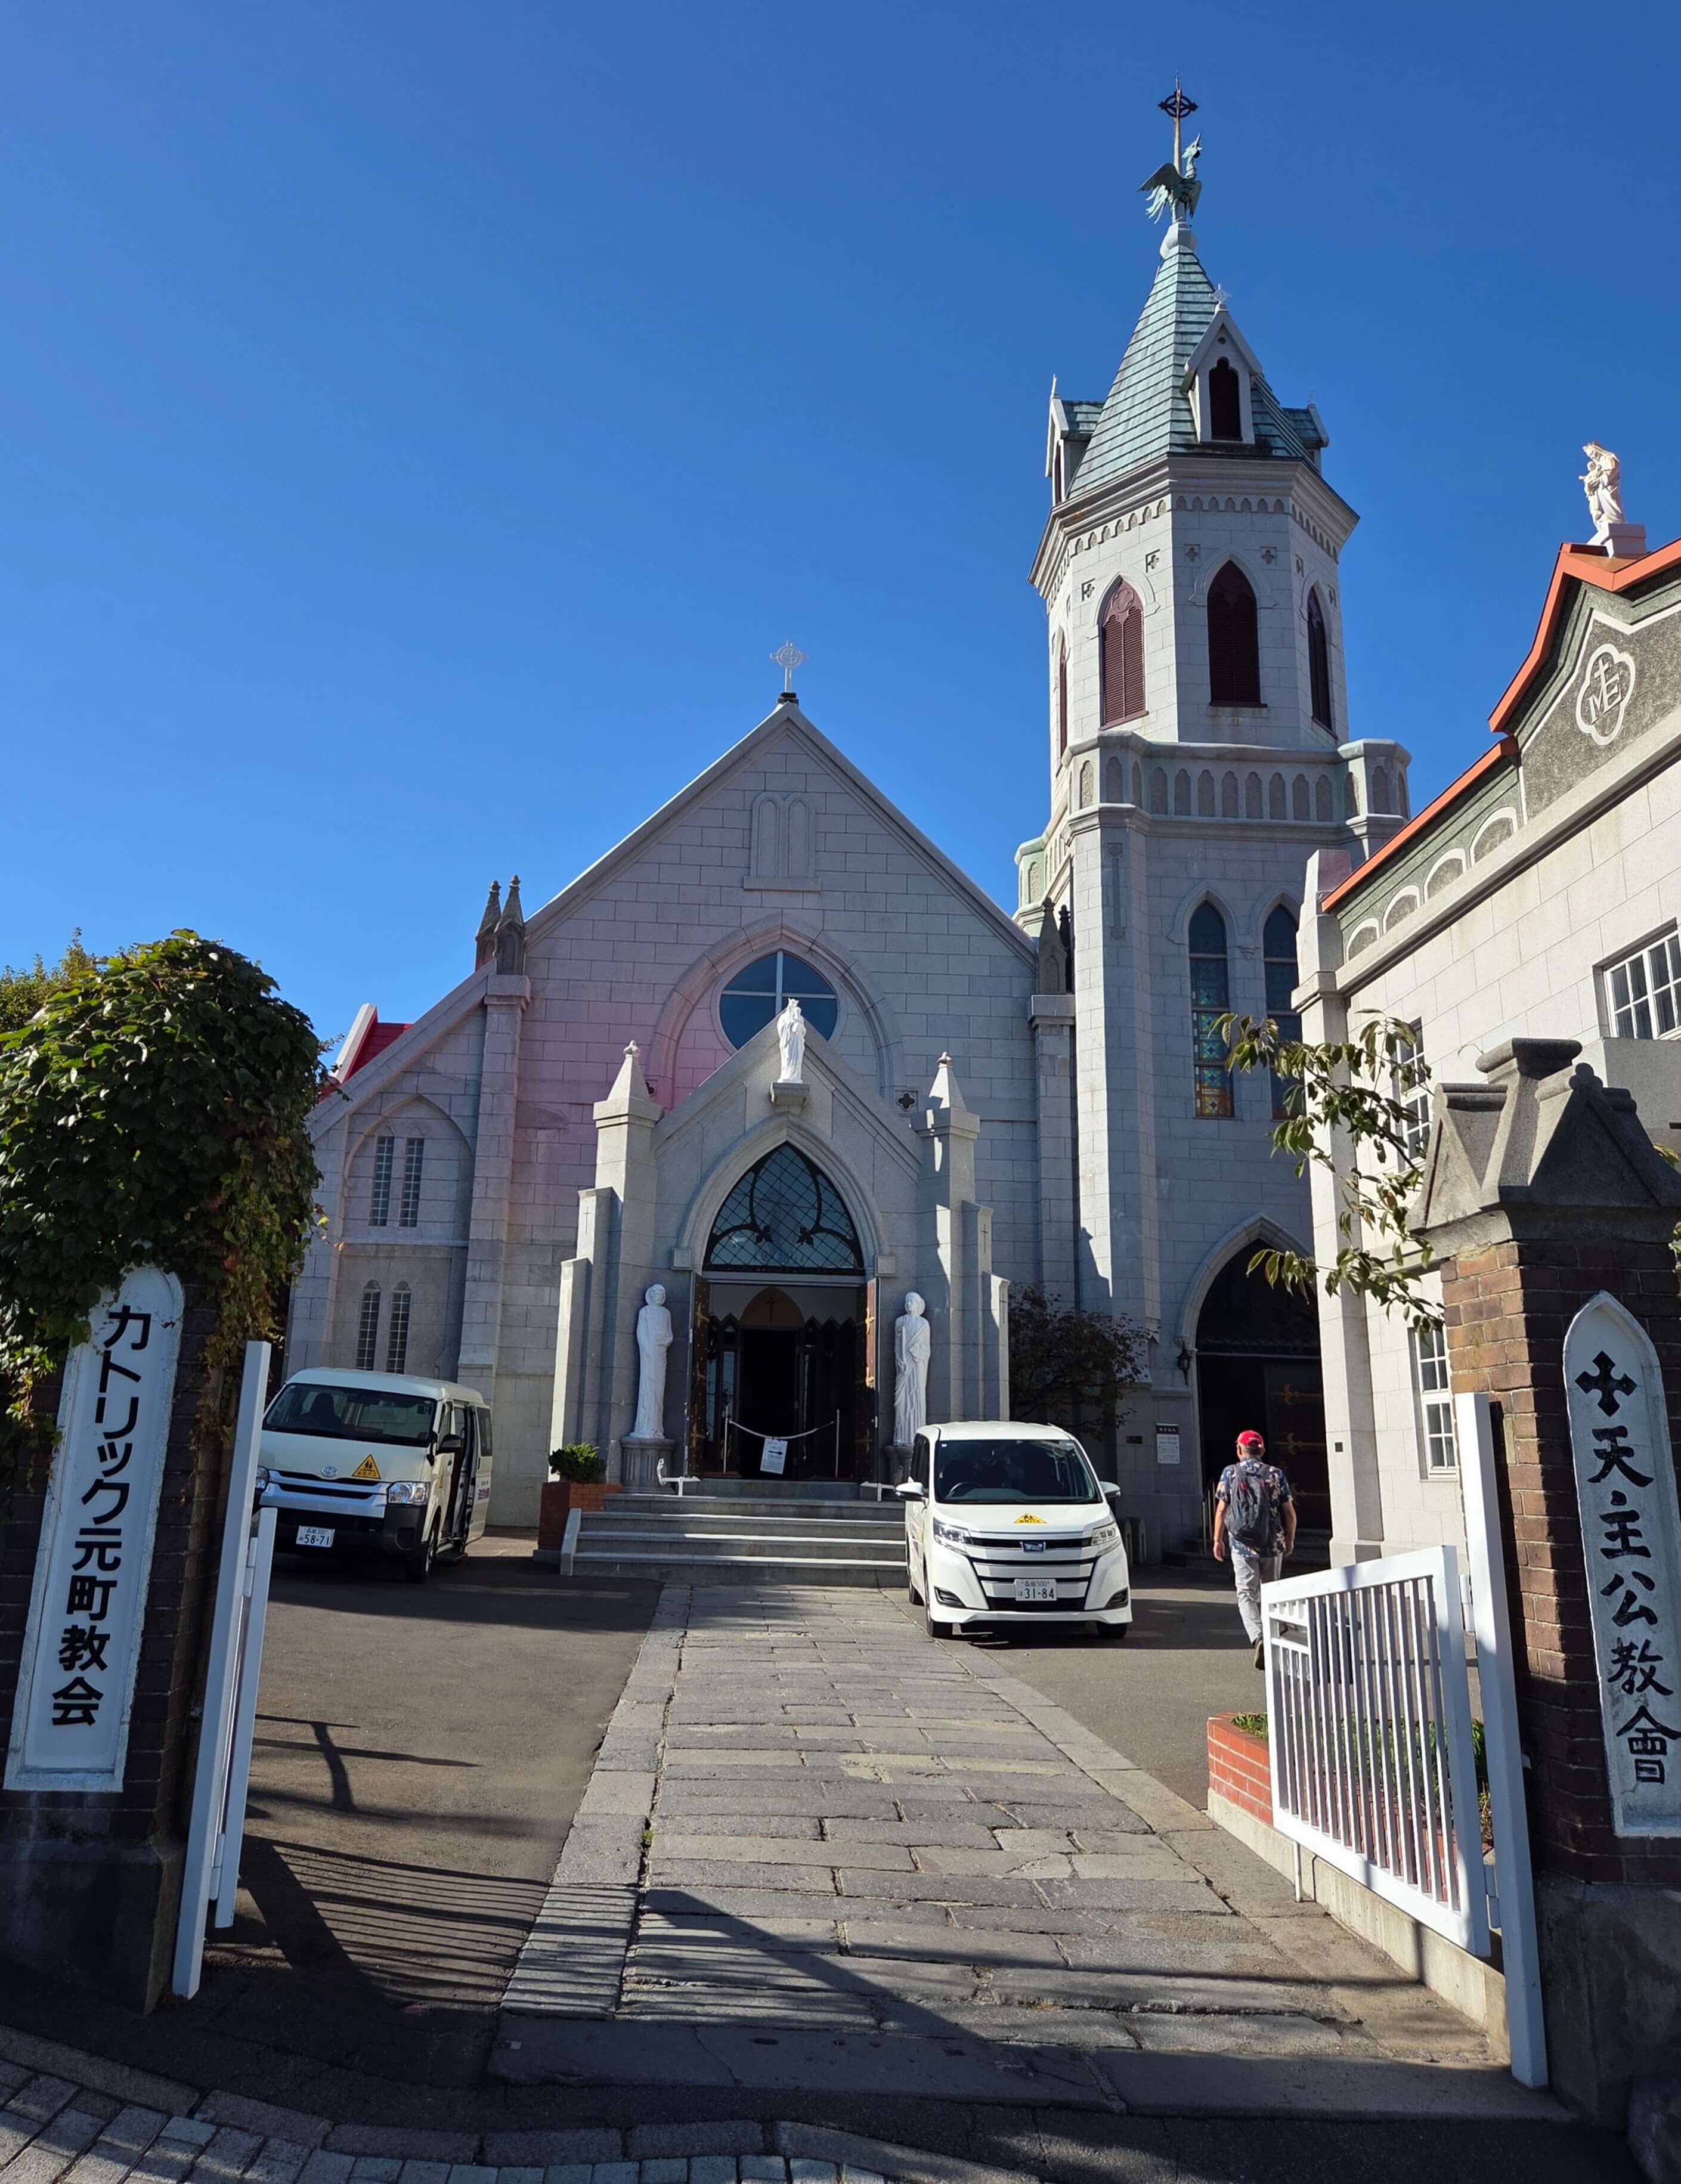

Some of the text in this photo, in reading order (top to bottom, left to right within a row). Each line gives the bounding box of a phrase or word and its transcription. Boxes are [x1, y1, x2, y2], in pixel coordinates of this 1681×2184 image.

[52, 1305, 151, 1726] カトリック元町教会
[305, 1534, 330, 1546] 58-71
[1024, 1588, 1054, 1599] 31-84
[1587, 1424, 1681, 1785] 天主公教會
